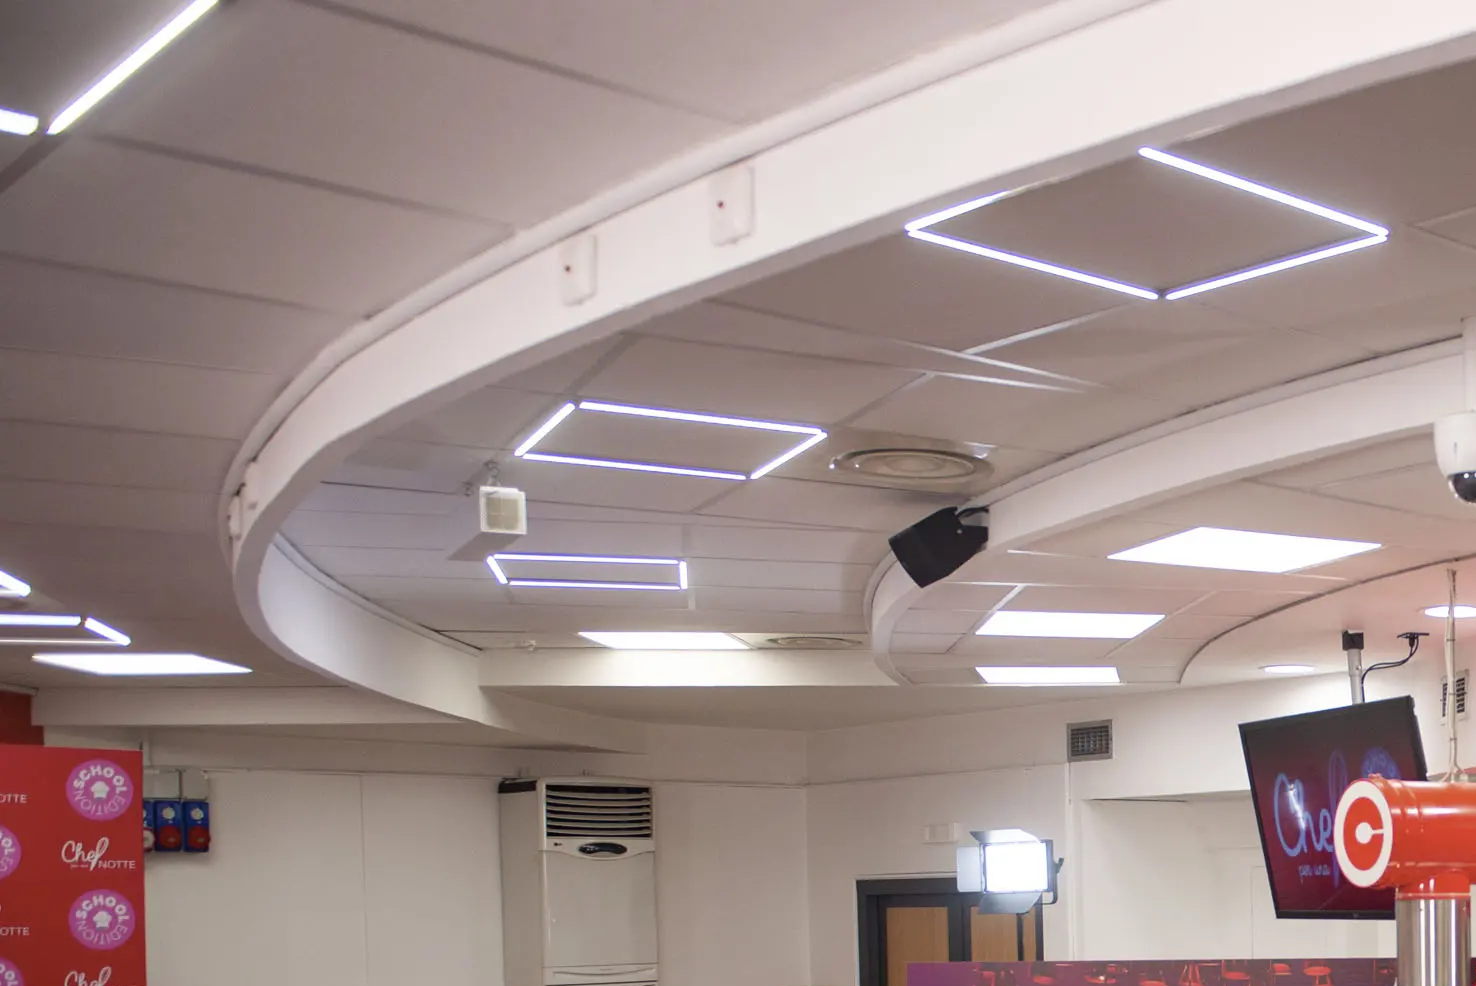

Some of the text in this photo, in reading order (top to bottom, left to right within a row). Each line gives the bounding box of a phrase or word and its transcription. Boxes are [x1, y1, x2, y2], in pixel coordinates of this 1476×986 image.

[73, 764, 128, 795] SCHOOL
[0, 793, 28, 804] OTTE
[73, 790, 126, 815] EDITION
[61, 836, 110, 872] Chef
[98, 860, 136, 870] NOTTE
[75, 894, 130, 922] SCHOOL
[0, 926, 30, 937] OTTE
[76, 919, 128, 945] EDITION
